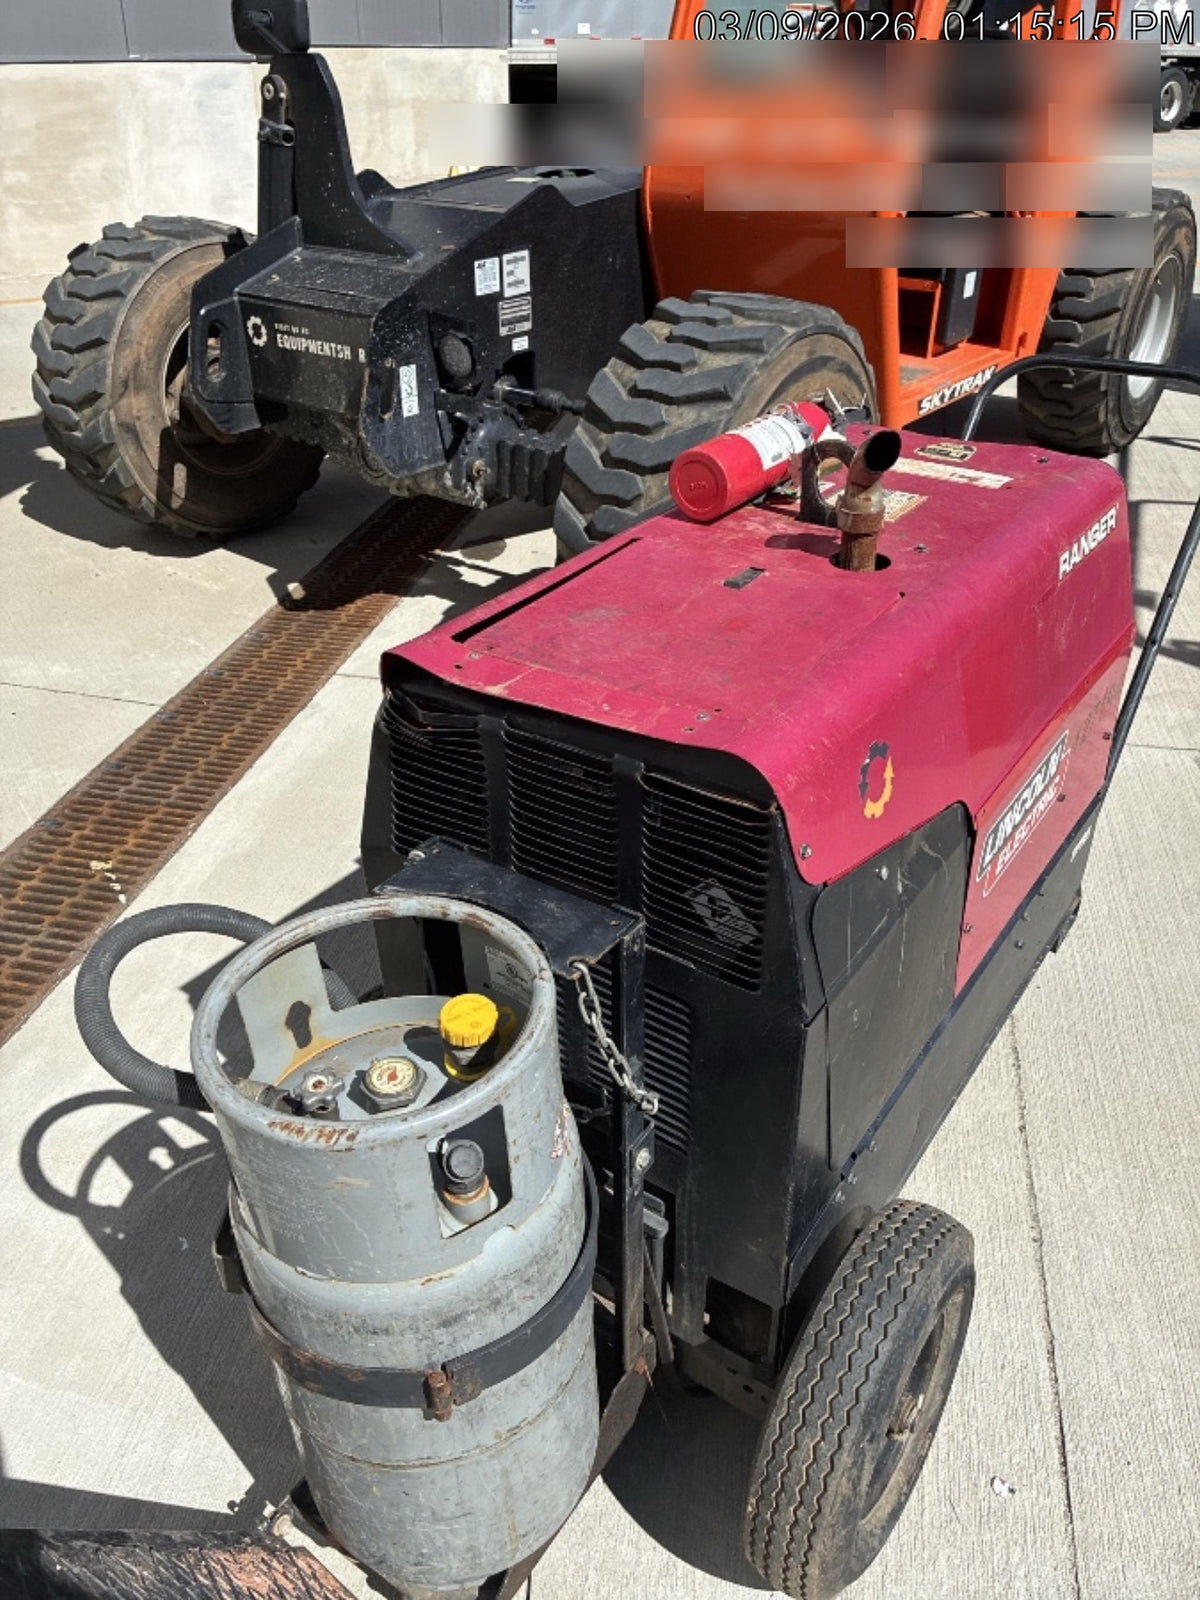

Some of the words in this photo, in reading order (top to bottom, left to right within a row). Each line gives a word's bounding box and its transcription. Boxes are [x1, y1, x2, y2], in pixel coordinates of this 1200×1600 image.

[918, 365, 998, 416] SKYTRAK
[1059, 506, 1117, 581] RANGER
[983, 744, 1063, 869] LINCOLN
[995, 775, 1061, 876] ELECTRIC
